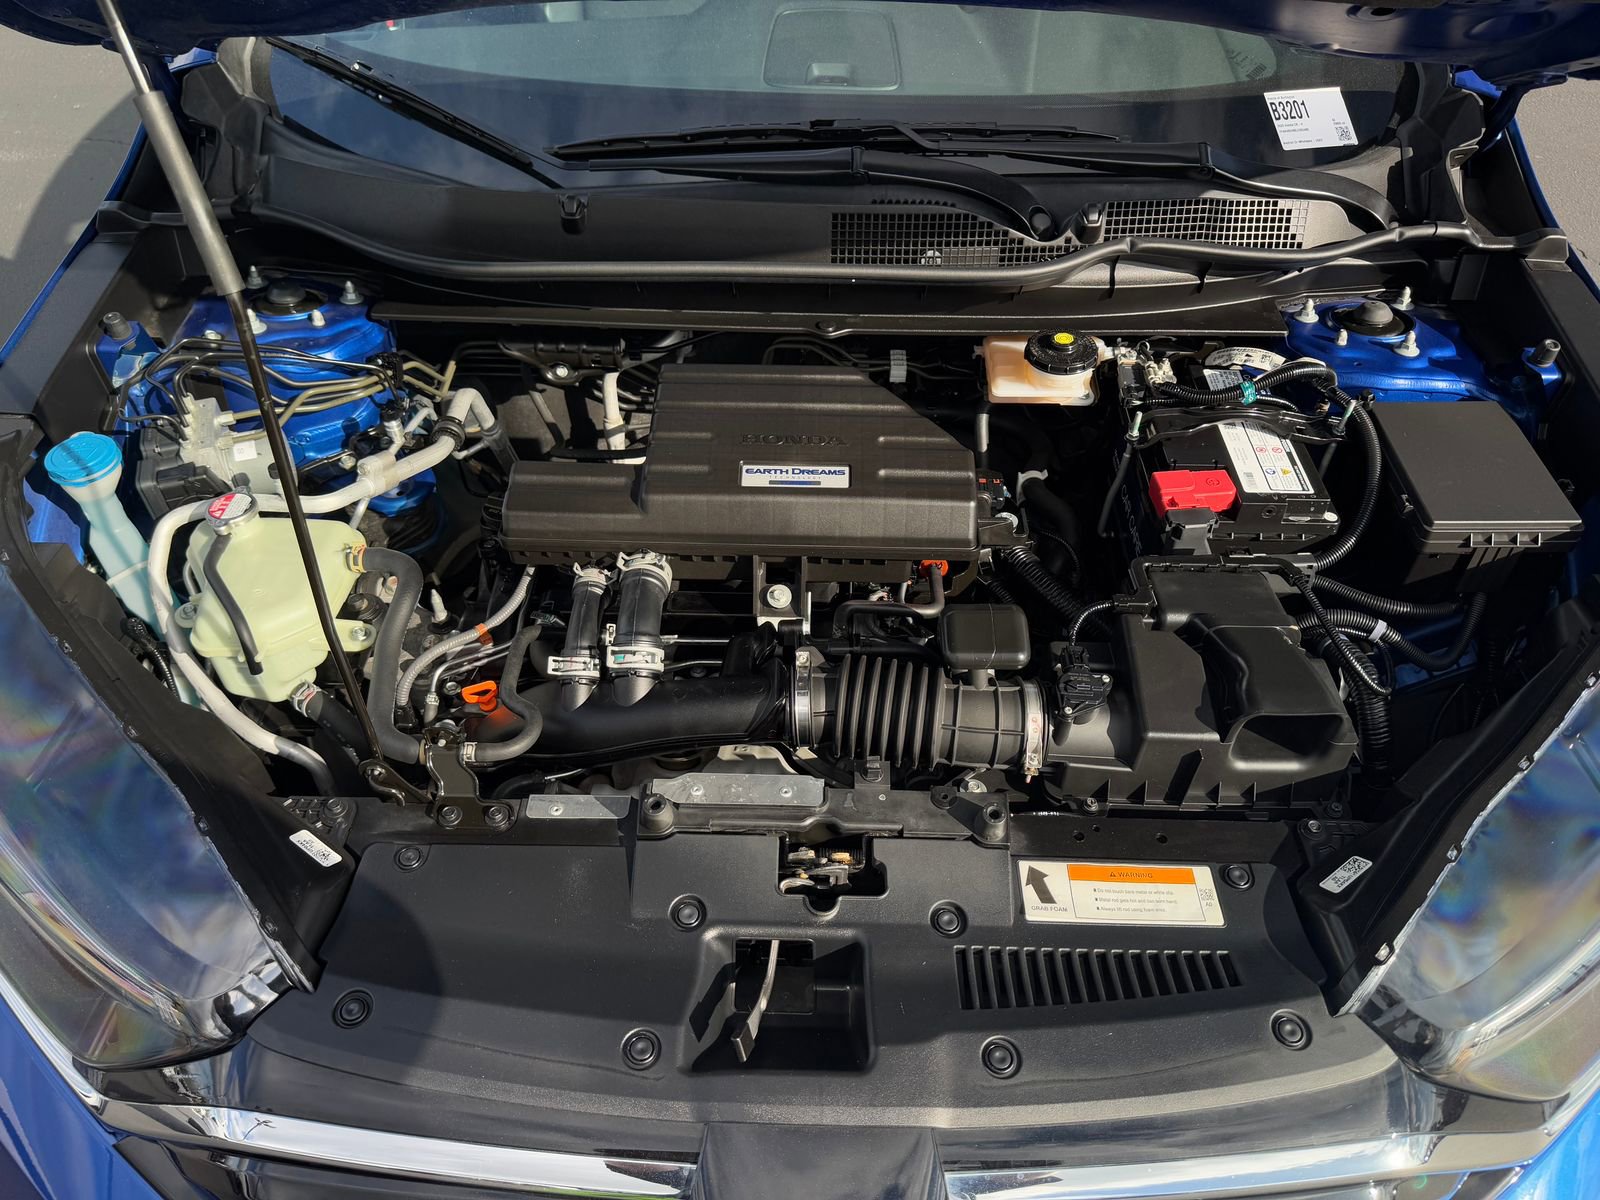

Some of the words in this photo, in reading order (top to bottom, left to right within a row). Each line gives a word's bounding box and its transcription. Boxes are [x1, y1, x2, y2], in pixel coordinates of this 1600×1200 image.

[1269, 99, 1310, 121] B3201
[741, 434, 850, 447] HONDA
[791, 468, 846, 476] DREAMS
[1117, 871, 1153, 879] WARNING
